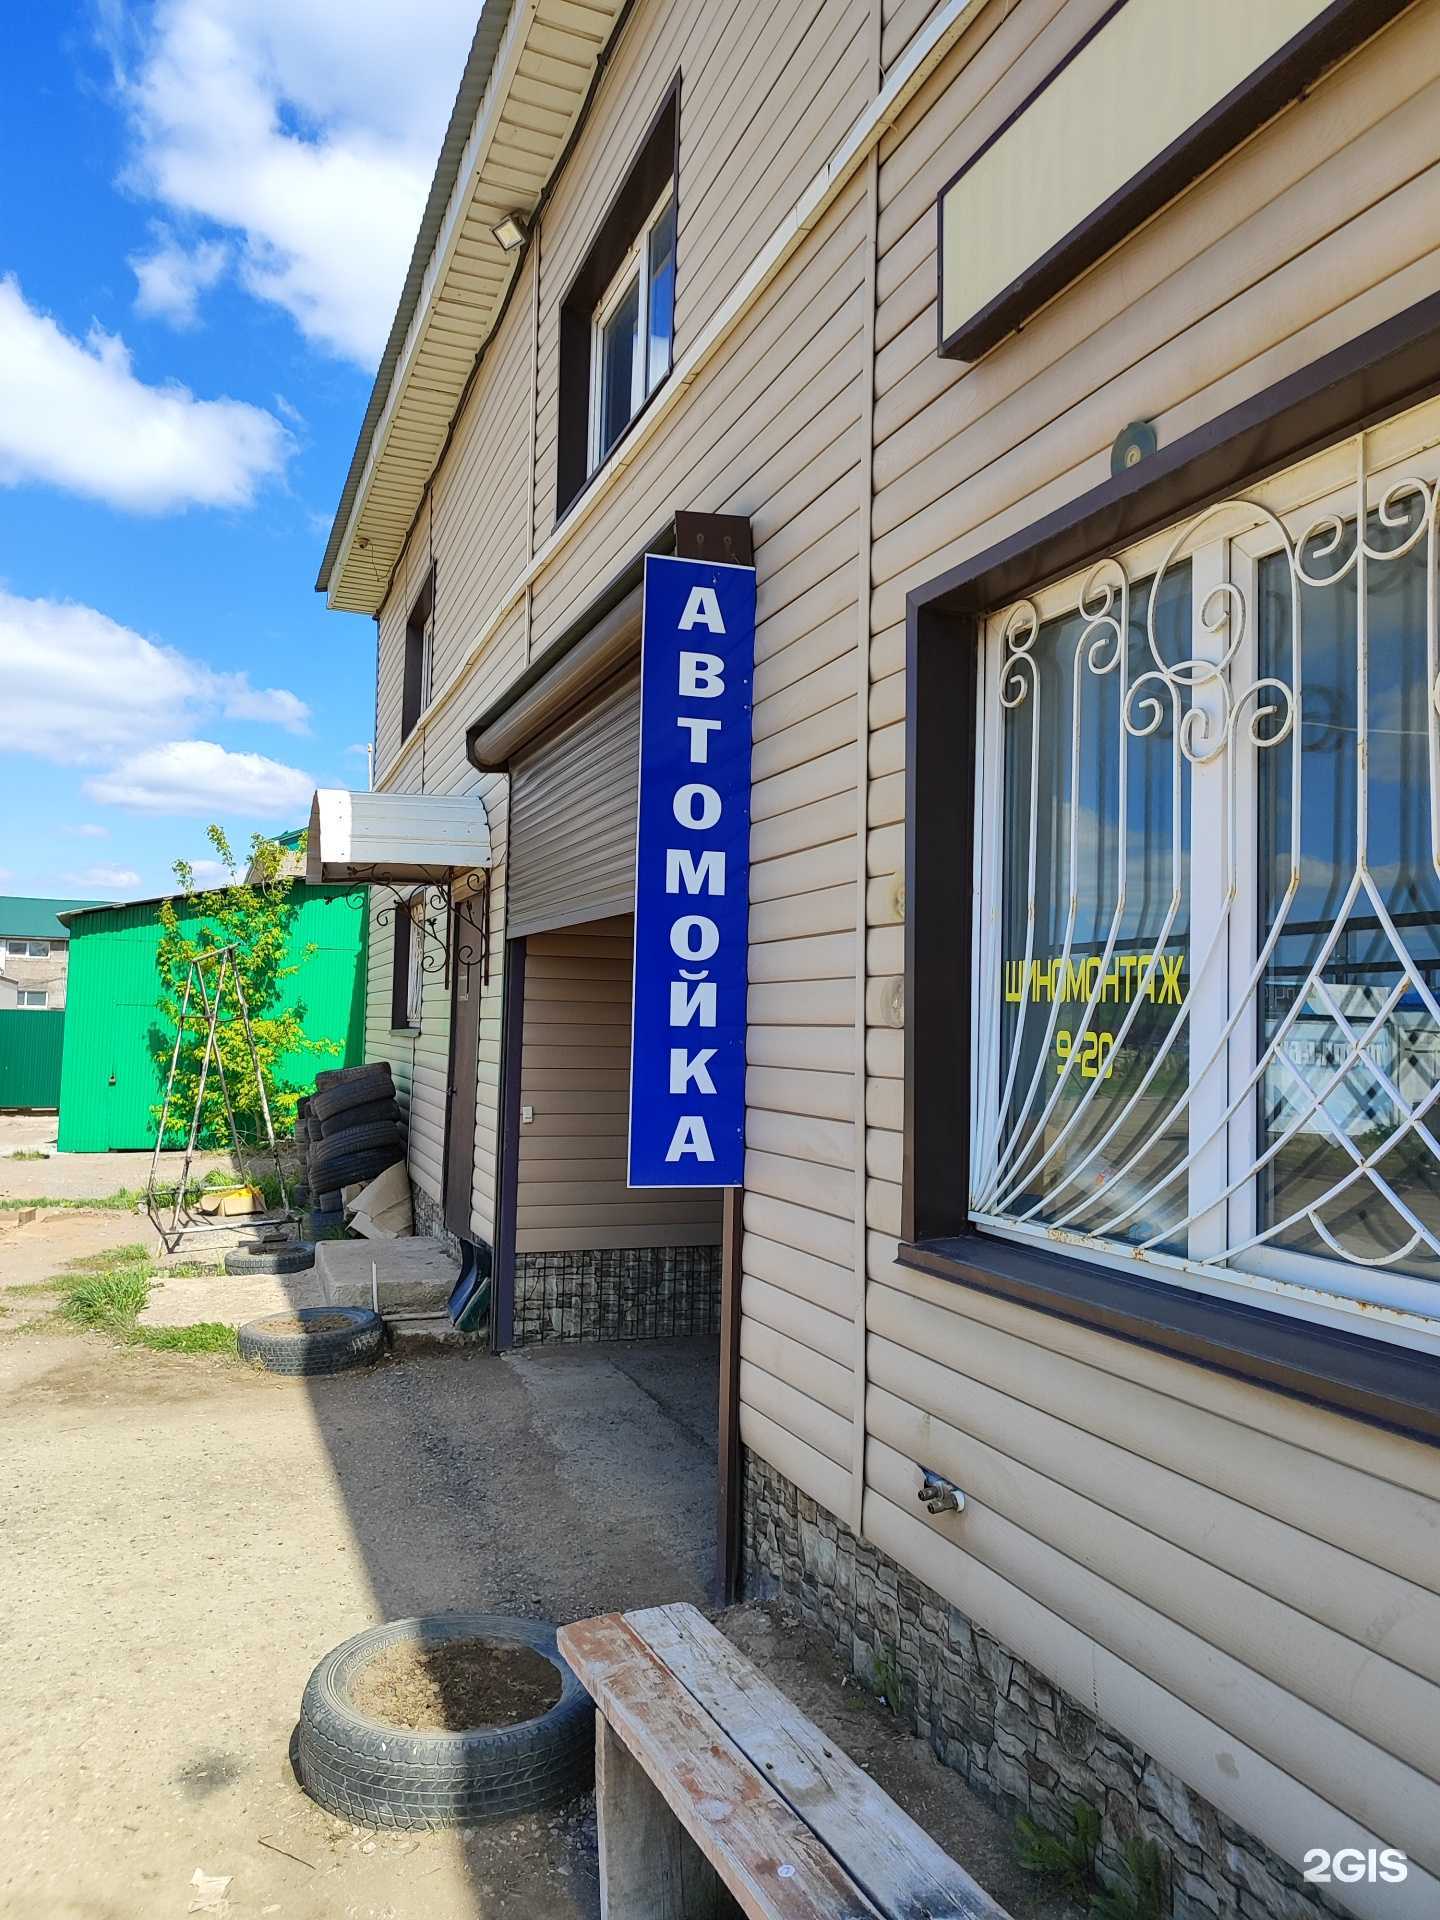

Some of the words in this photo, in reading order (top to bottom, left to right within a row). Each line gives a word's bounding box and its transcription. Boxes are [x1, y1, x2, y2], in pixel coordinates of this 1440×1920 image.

[665, 585, 726, 1162] АВТОМОЙКА
[1005, 955, 1184, 1005] ШИНОМОНТАЖ
[1056, 1030, 1114, 1079] 9-20
